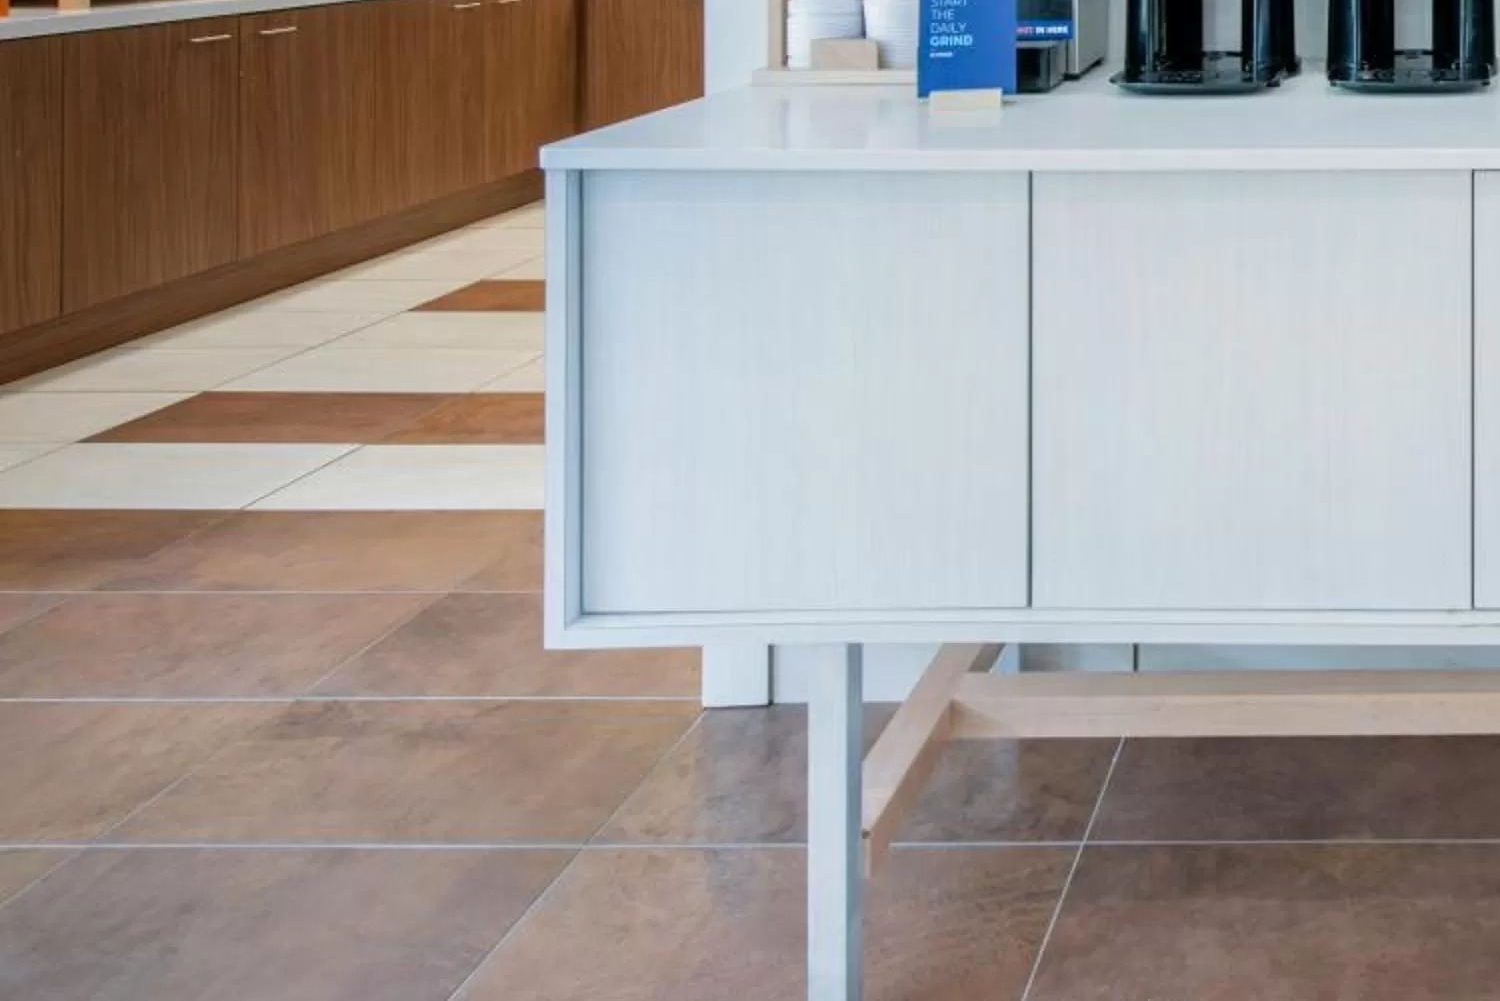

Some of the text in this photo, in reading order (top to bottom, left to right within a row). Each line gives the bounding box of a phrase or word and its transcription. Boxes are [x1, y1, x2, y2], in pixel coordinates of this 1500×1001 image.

[931, 9, 955, 20] THE
[930, 22, 967, 34] DAILY
[929, 34, 973, 48] GRIND
